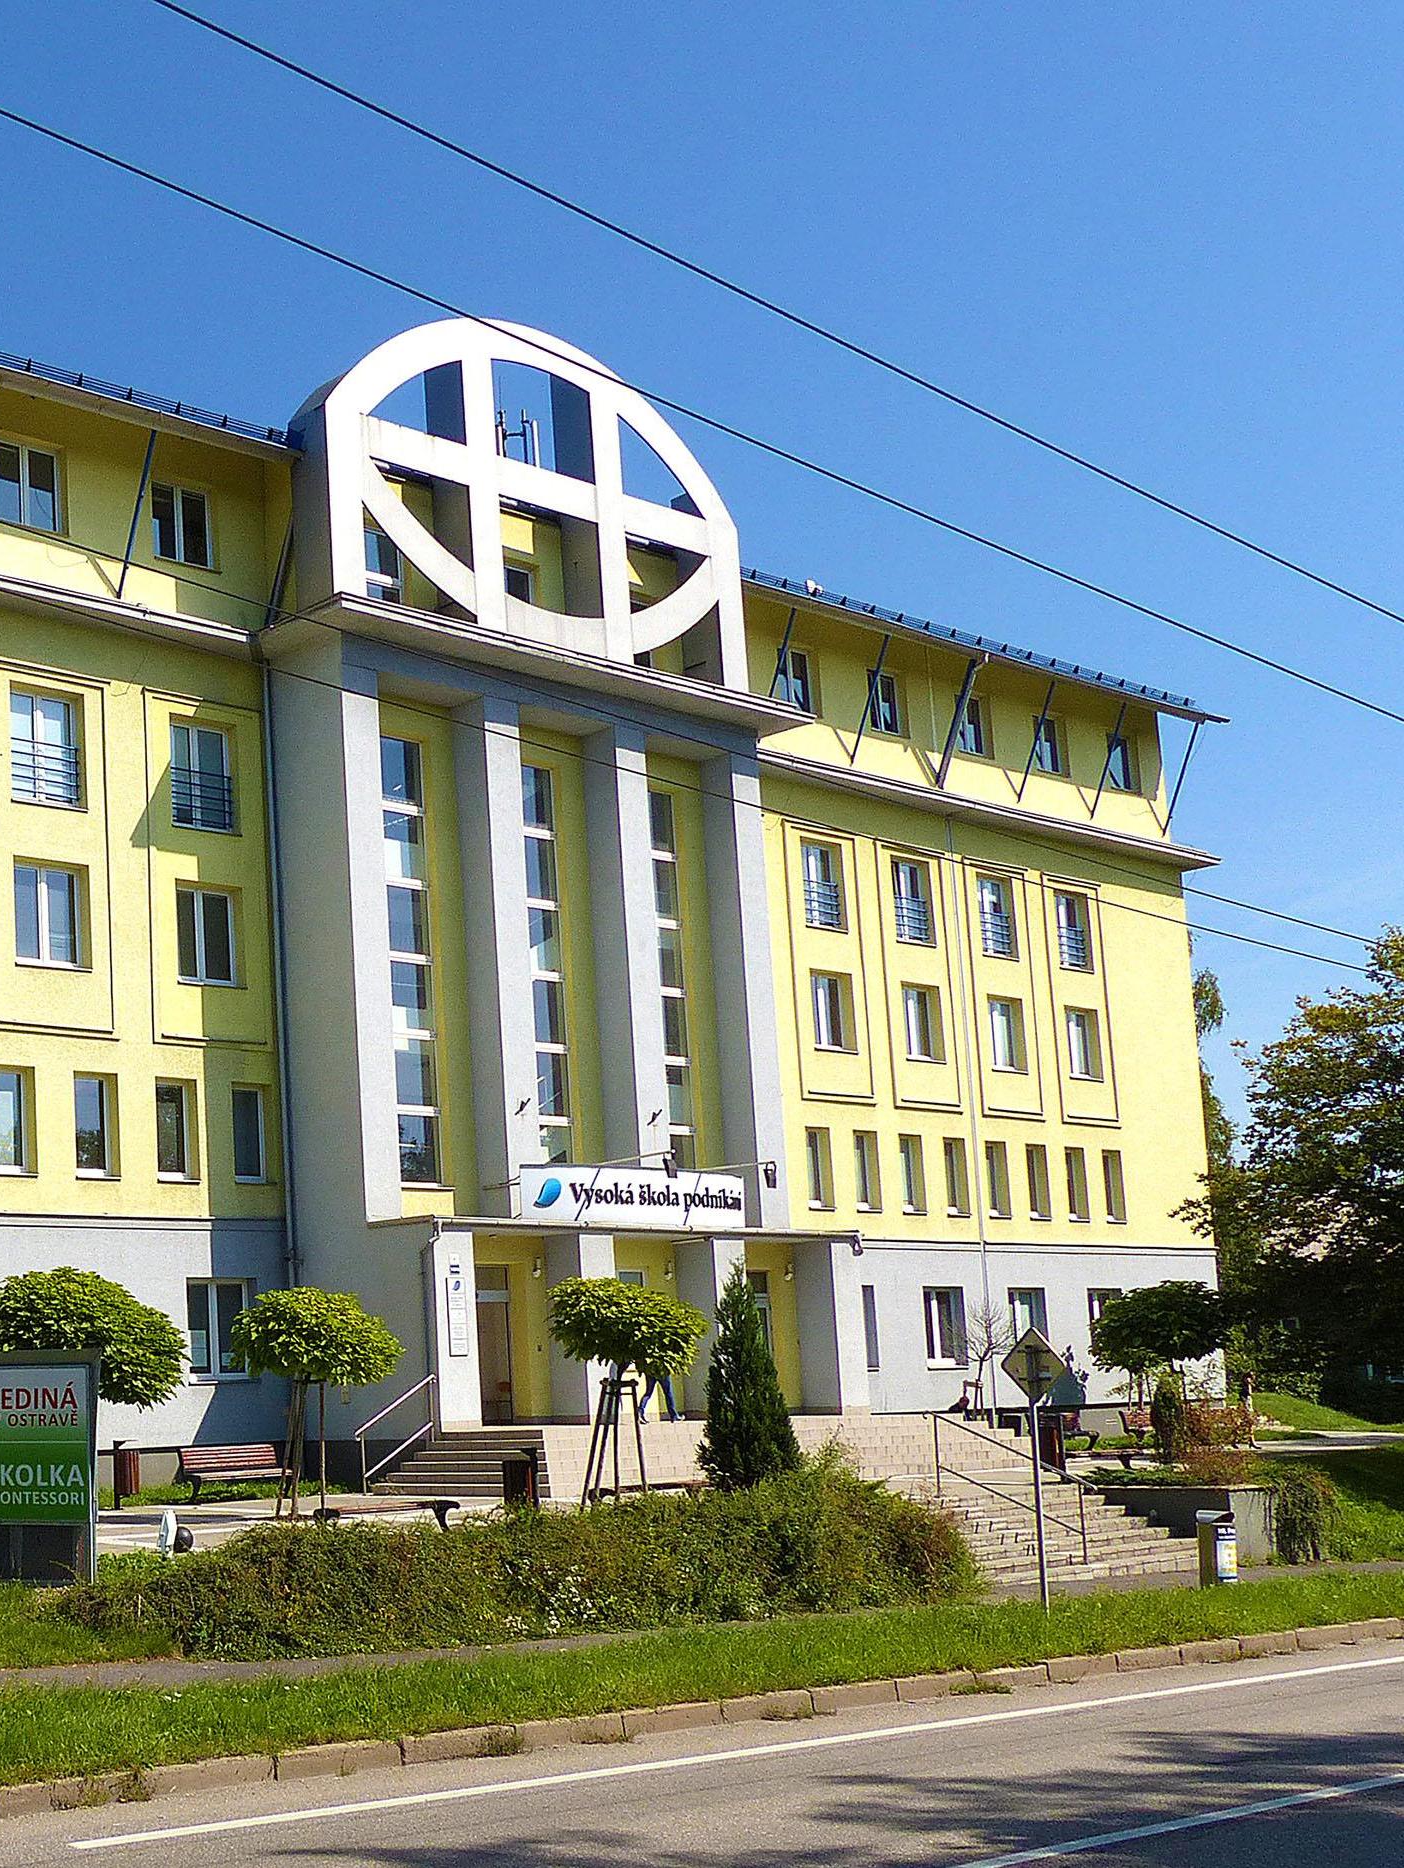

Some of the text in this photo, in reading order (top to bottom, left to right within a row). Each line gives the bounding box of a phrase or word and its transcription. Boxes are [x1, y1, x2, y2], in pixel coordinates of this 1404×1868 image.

[569, 1182, 634, 1210] Vysoká
[638, 1183, 680, 1206] škola
[7, 1409, 79, 1427] OSTRAVĚ
